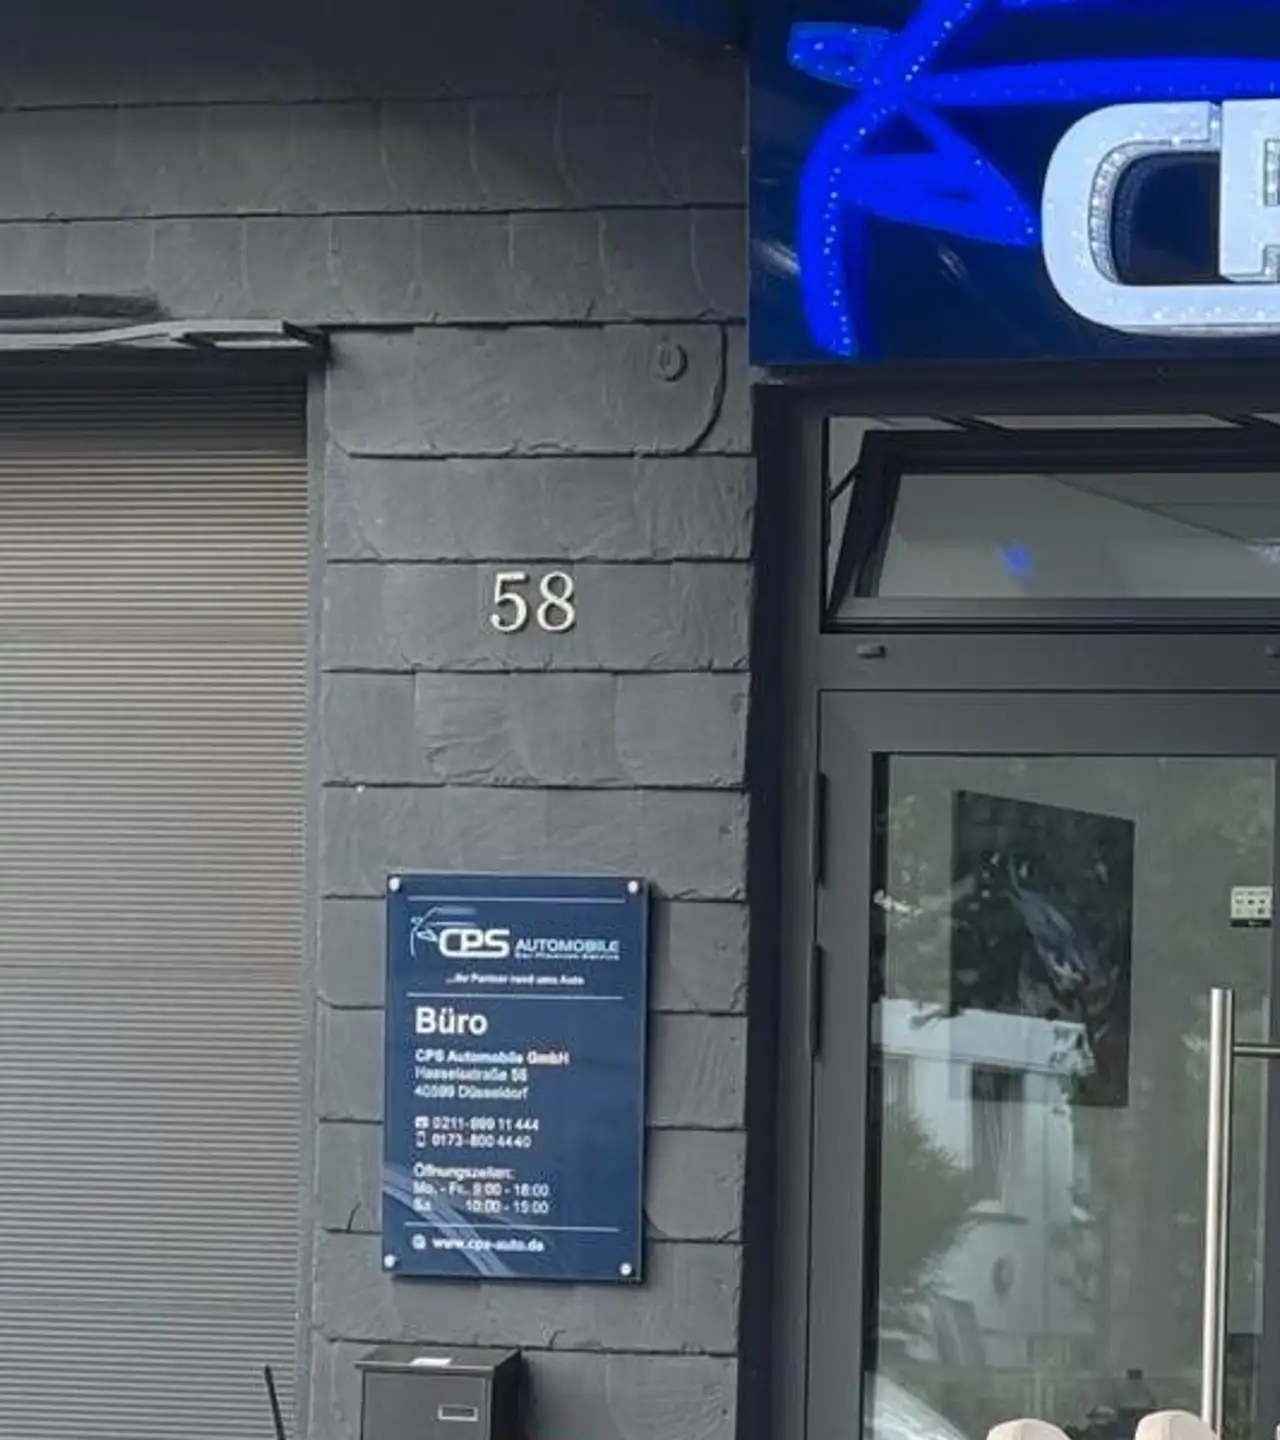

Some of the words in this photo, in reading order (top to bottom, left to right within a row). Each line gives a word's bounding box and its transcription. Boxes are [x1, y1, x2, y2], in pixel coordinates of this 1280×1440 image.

[490, 570, 575, 632] 58
[438, 928, 510, 959] CPS
[514, 938, 620, 952] AUTOMOBILE
[415, 1006, 488, 1035] Büro
[415, 1049, 444, 1062] CPS
[447, 1049, 524, 1064] Automobile
[527, 1051, 570, 1065] GmbH
[458, 1085, 529, 1100] Düsseldorf
